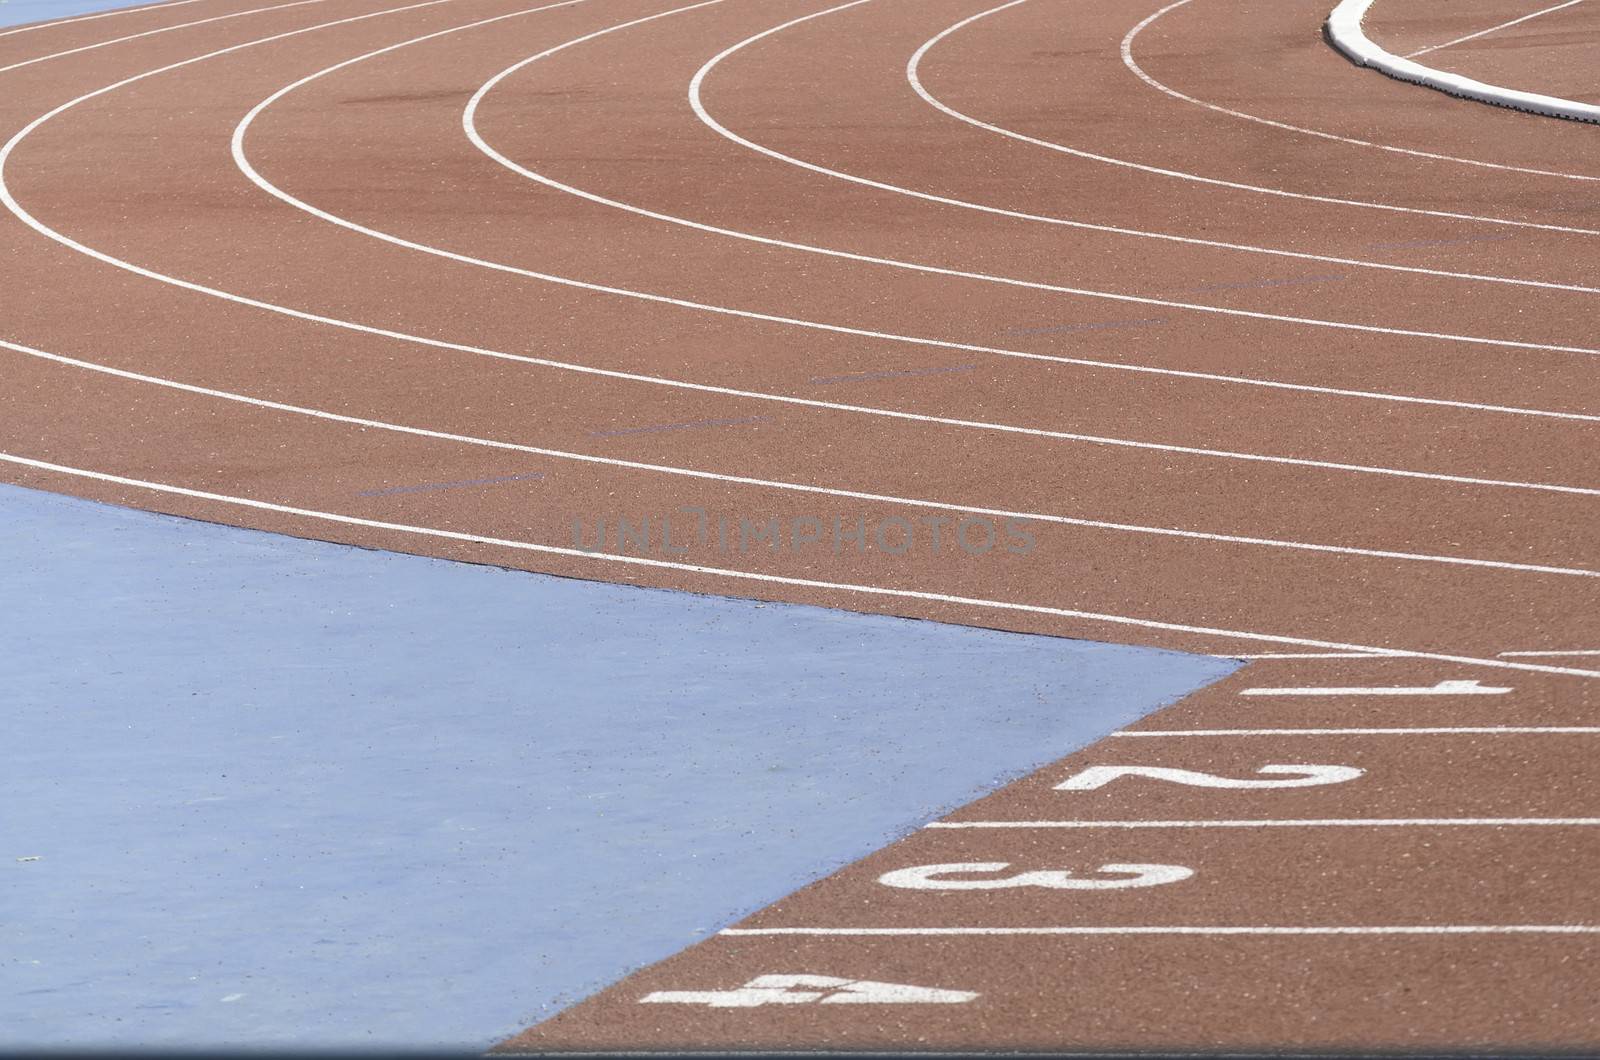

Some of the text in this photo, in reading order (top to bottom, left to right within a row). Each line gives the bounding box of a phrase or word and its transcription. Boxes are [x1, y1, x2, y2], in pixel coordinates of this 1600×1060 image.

[1239, 680, 1513, 697] 1
[1052, 763, 1365, 791] 2
[877, 862, 1194, 891] 3
[638, 973, 980, 1008] 4
